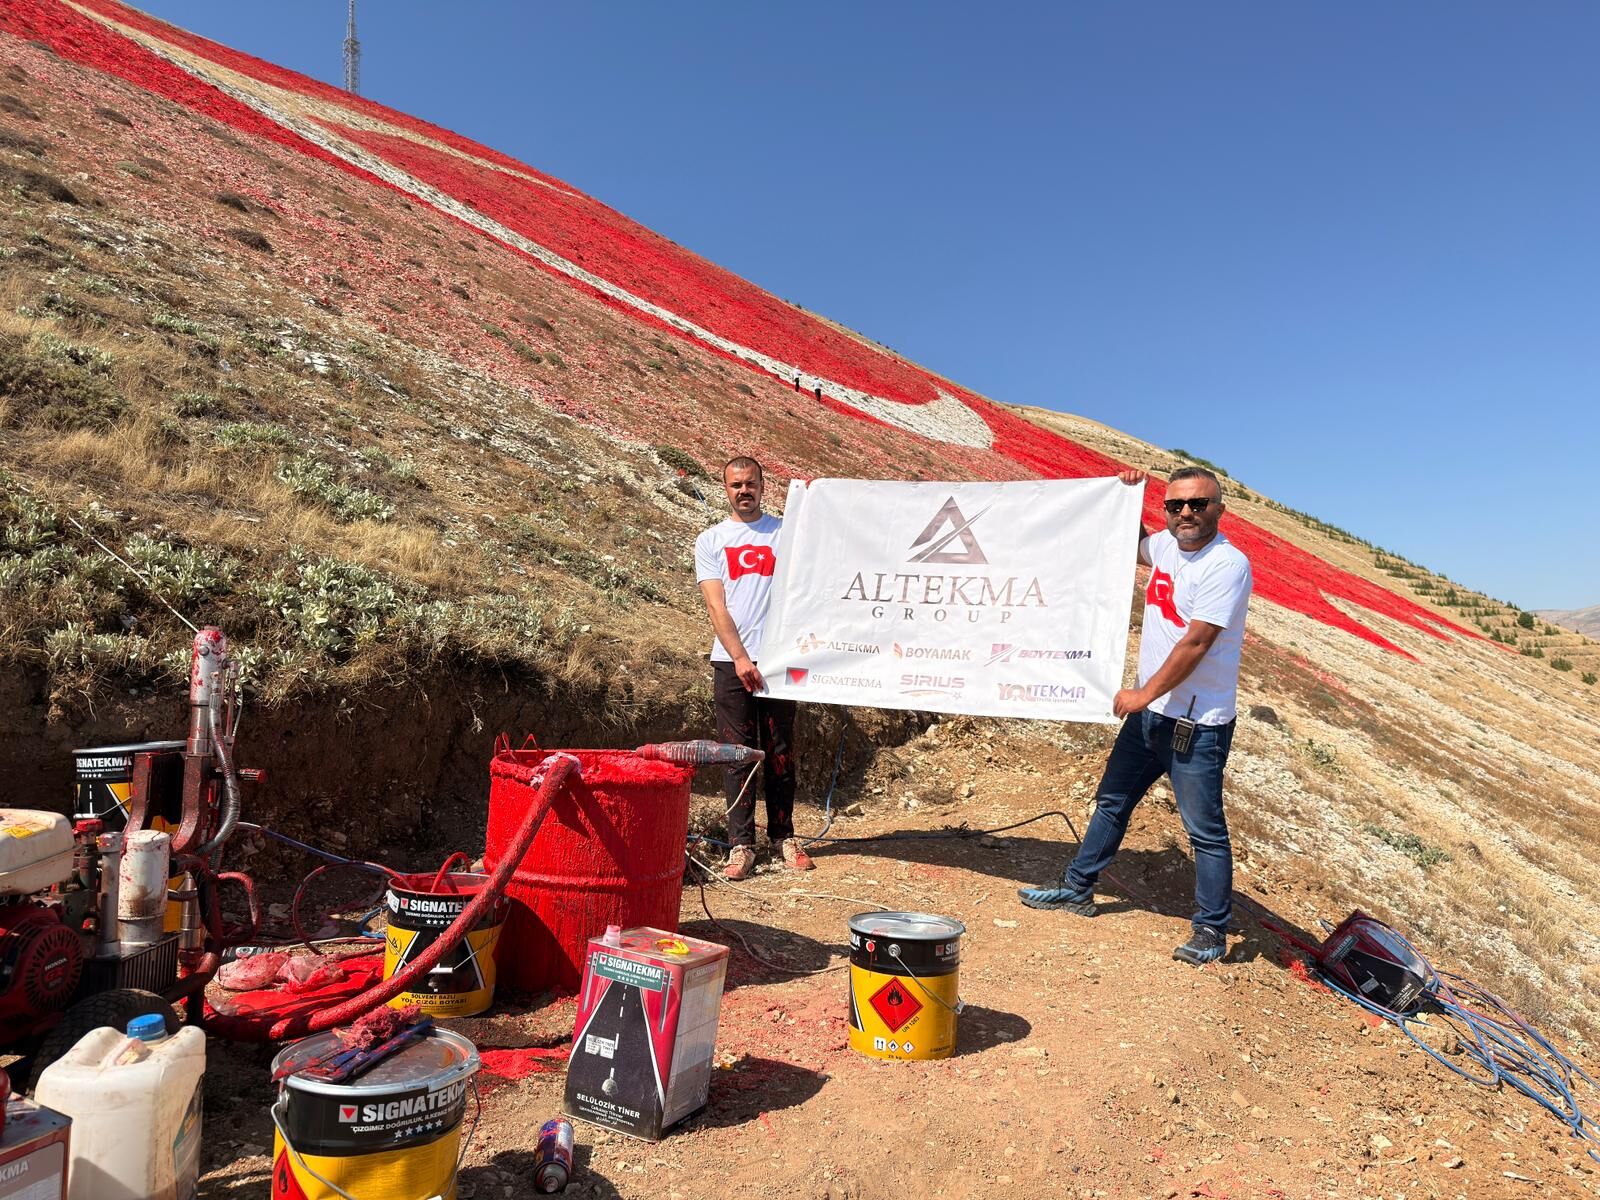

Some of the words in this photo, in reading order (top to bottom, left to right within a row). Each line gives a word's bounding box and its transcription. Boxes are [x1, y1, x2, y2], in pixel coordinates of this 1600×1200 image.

[841, 571, 1048, 608] ALTEKMA
[872, 605, 1012, 624] GROUP
[827, 641, 881, 655] ALTEKMA
[905, 647, 972, 661] BOYAMAK
[1018, 649, 1092, 660] BOYTEKMA
[811, 673, 883, 690] SIGNATEKMA
[900, 674, 966, 689] SIRIUS
[607, 956, 662, 980] SIGNATEKMA
[901, 1025, 911, 1033] UN
[617, 1105, 641, 1119] TİNER
